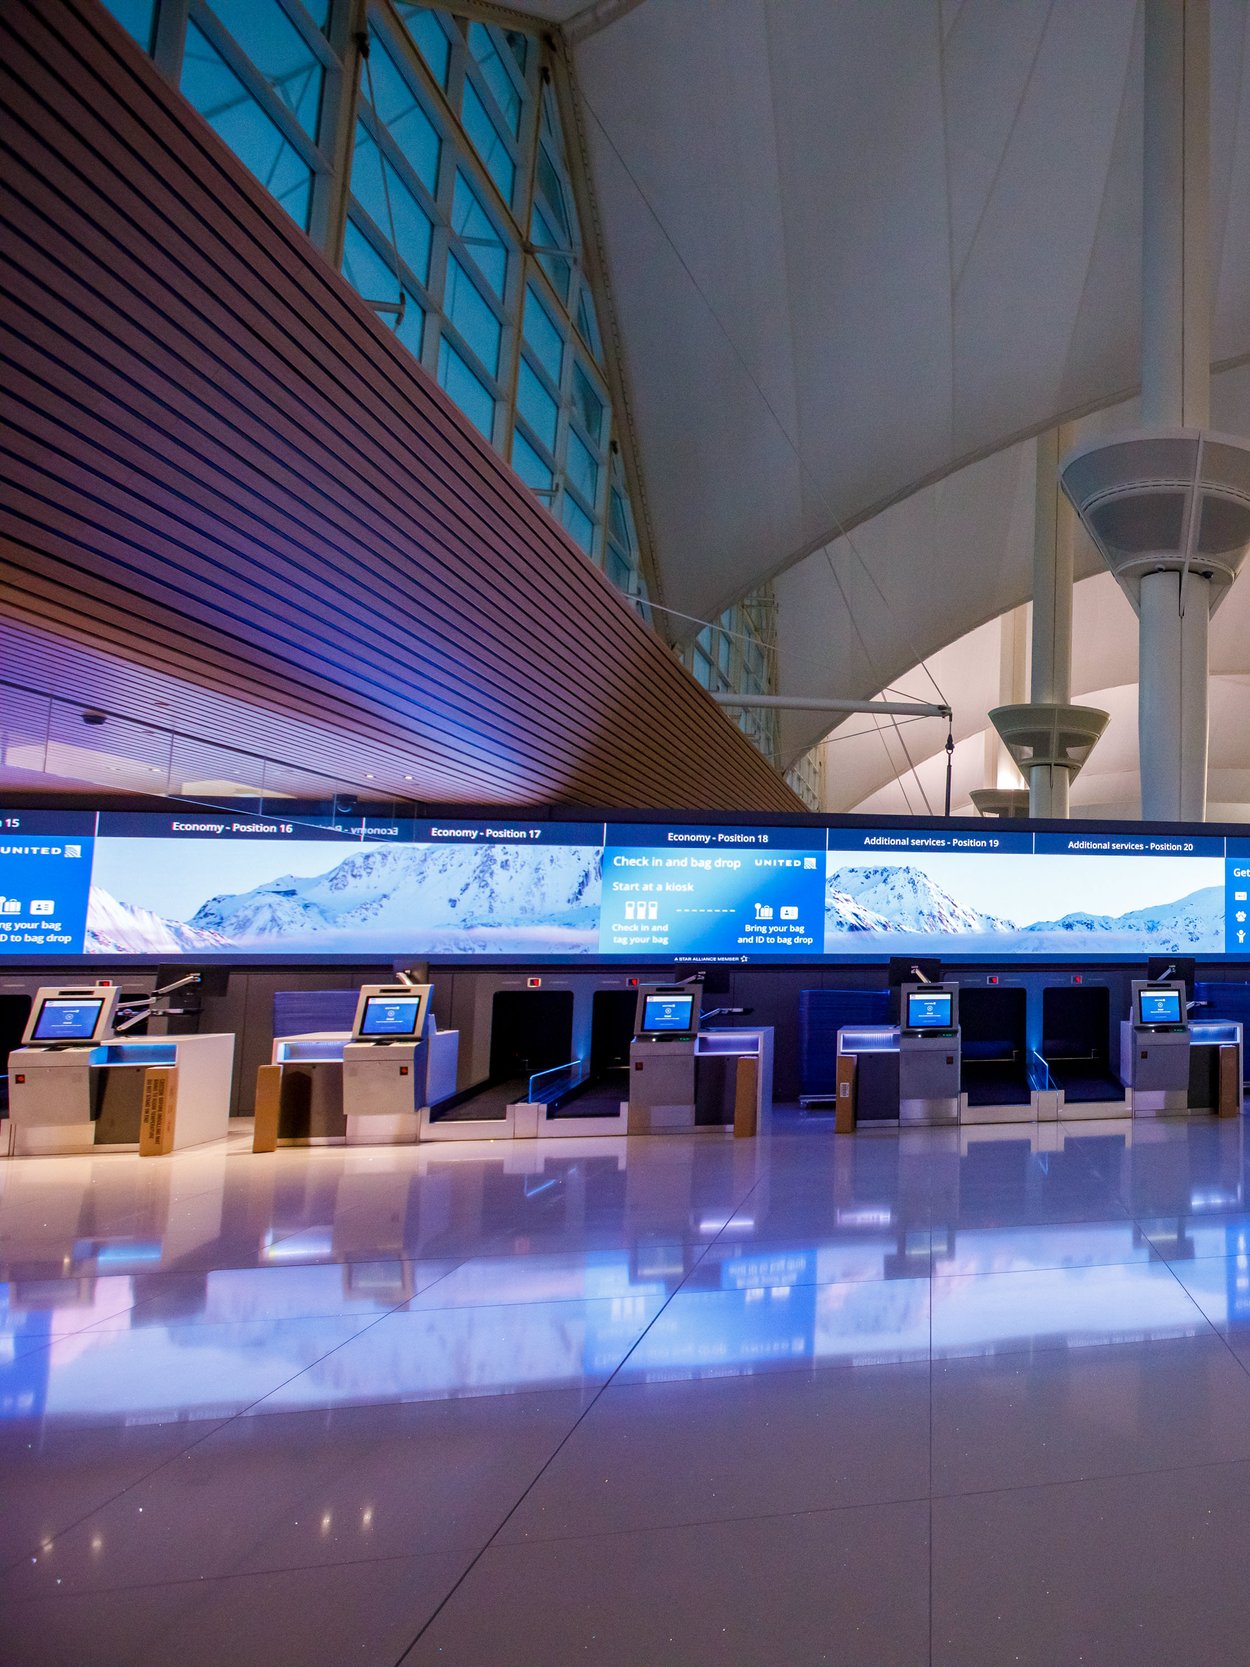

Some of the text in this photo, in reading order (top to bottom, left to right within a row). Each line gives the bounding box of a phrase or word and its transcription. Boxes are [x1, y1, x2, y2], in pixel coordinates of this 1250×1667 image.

[5, 818, 20, 828] 15
[172, 822, 224, 833] Economy
[232, 822, 276, 832] Position
[280, 824, 293, 833] 16
[431, 828, 478, 839] Economy
[486, 828, 526, 838] Position
[529, 830, 541, 838] 17
[668, 833, 710, 844] Economy
[718, 833, 755, 842] Position
[758, 835, 768, 843] 18
[864, 836, 909, 846] Additional
[911, 837, 945, 846] services
[952, 838, 987, 847] Position
[989, 839, 999, 848] 19
[1068, 840, 1109, 850] Additional
[1111, 842, 1143, 850] services
[1150, 842, 1182, 851] Position
[1184, 843, 1194, 851] 20
[0, 847, 62, 855] UNITED
[613, 856, 741, 870] Check in and bag drop
[755, 859, 801, 867] UNITED
[1233, 868, 1250, 877] Get
[612, 882, 639, 891] Start
[642, 883, 652, 891] at
[666, 881, 694, 891] kiosk
[14, 922, 40, 931] your
[41, 921, 62, 931] bag
[611, 924, 669, 932] Check in and
[745, 924, 805, 934] Bring your bag
[10, 934, 22, 942] to
[24, 933, 44, 944] bag
[46, 933, 72, 944] drop
[613, 936, 669, 945] tag your bag
[737, 936, 754, 944] and
[777, 936, 792, 945] bag
[795, 936, 813, 945] drop
